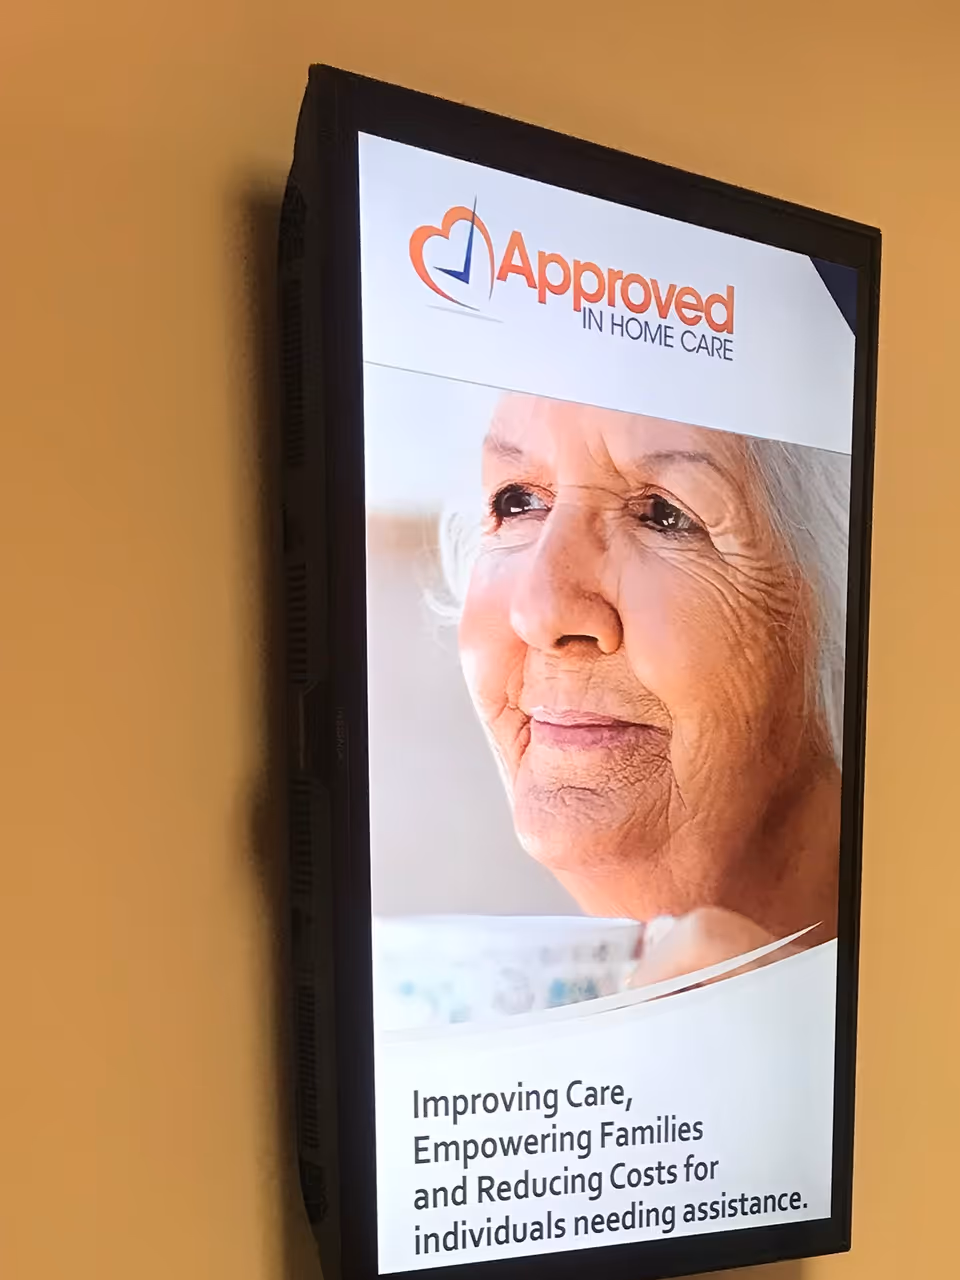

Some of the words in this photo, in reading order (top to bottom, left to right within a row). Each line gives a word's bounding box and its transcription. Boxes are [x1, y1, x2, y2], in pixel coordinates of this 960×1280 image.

[497, 230, 735, 334] Approved
[583, 307, 603, 333] IN
[611, 313, 674, 348] HOME
[681, 330, 734, 362] CARE
[413, 1082, 559, 1124] Improving
[566, 1080, 633, 1112] Care,
[414, 1124, 592, 1168] Empowering
[600, 1115, 704, 1149] Families
[414, 1176, 467, 1210] and
[477, 1166, 602, 1204] Reducing
[610, 1161, 678, 1191] Costs
[684, 1154, 719, 1182] for
[414, 1211, 566, 1255] individuals
[574, 1201, 676, 1236] needing
[683, 1190, 808, 1223] assistance.
